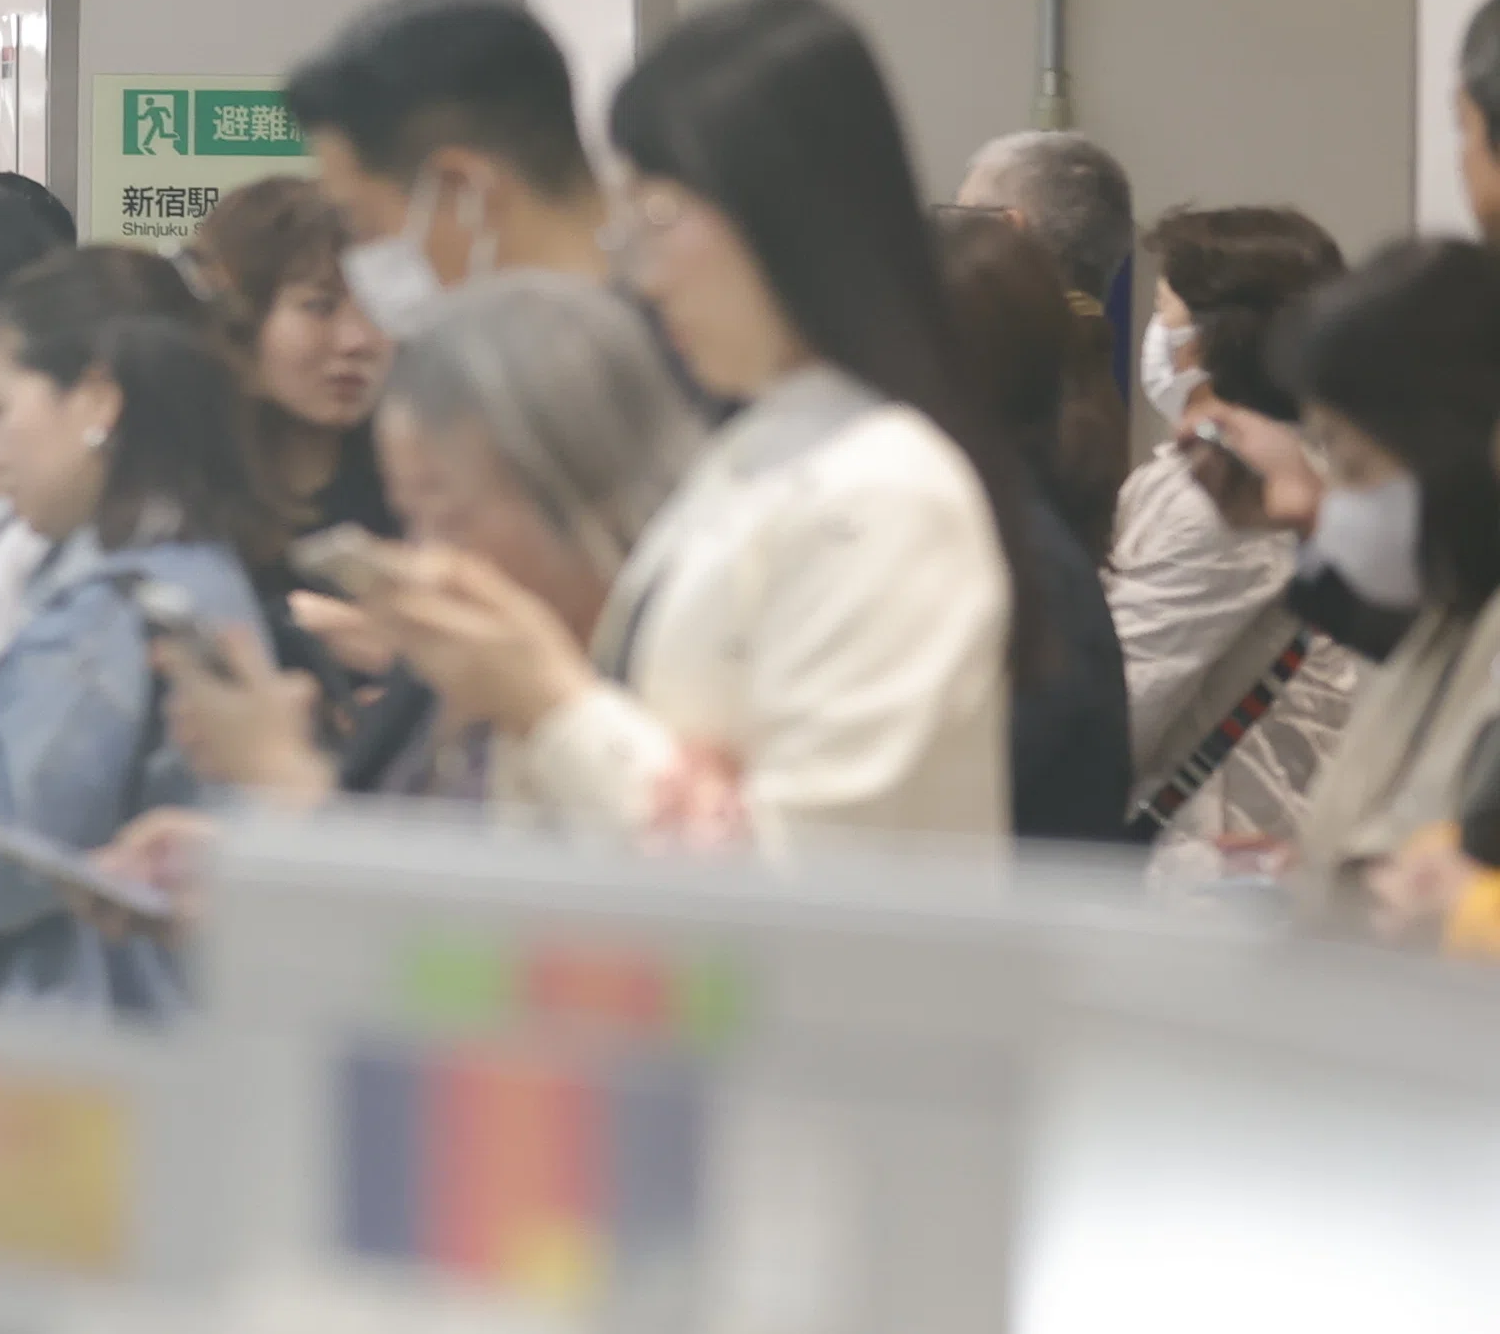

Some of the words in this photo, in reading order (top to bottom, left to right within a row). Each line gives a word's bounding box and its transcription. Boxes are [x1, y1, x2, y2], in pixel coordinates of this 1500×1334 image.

[211, 105, 304, 143] 避難
[122, 184, 219, 219] 新宿駅
[122, 221, 189, 239] Shinjuku
